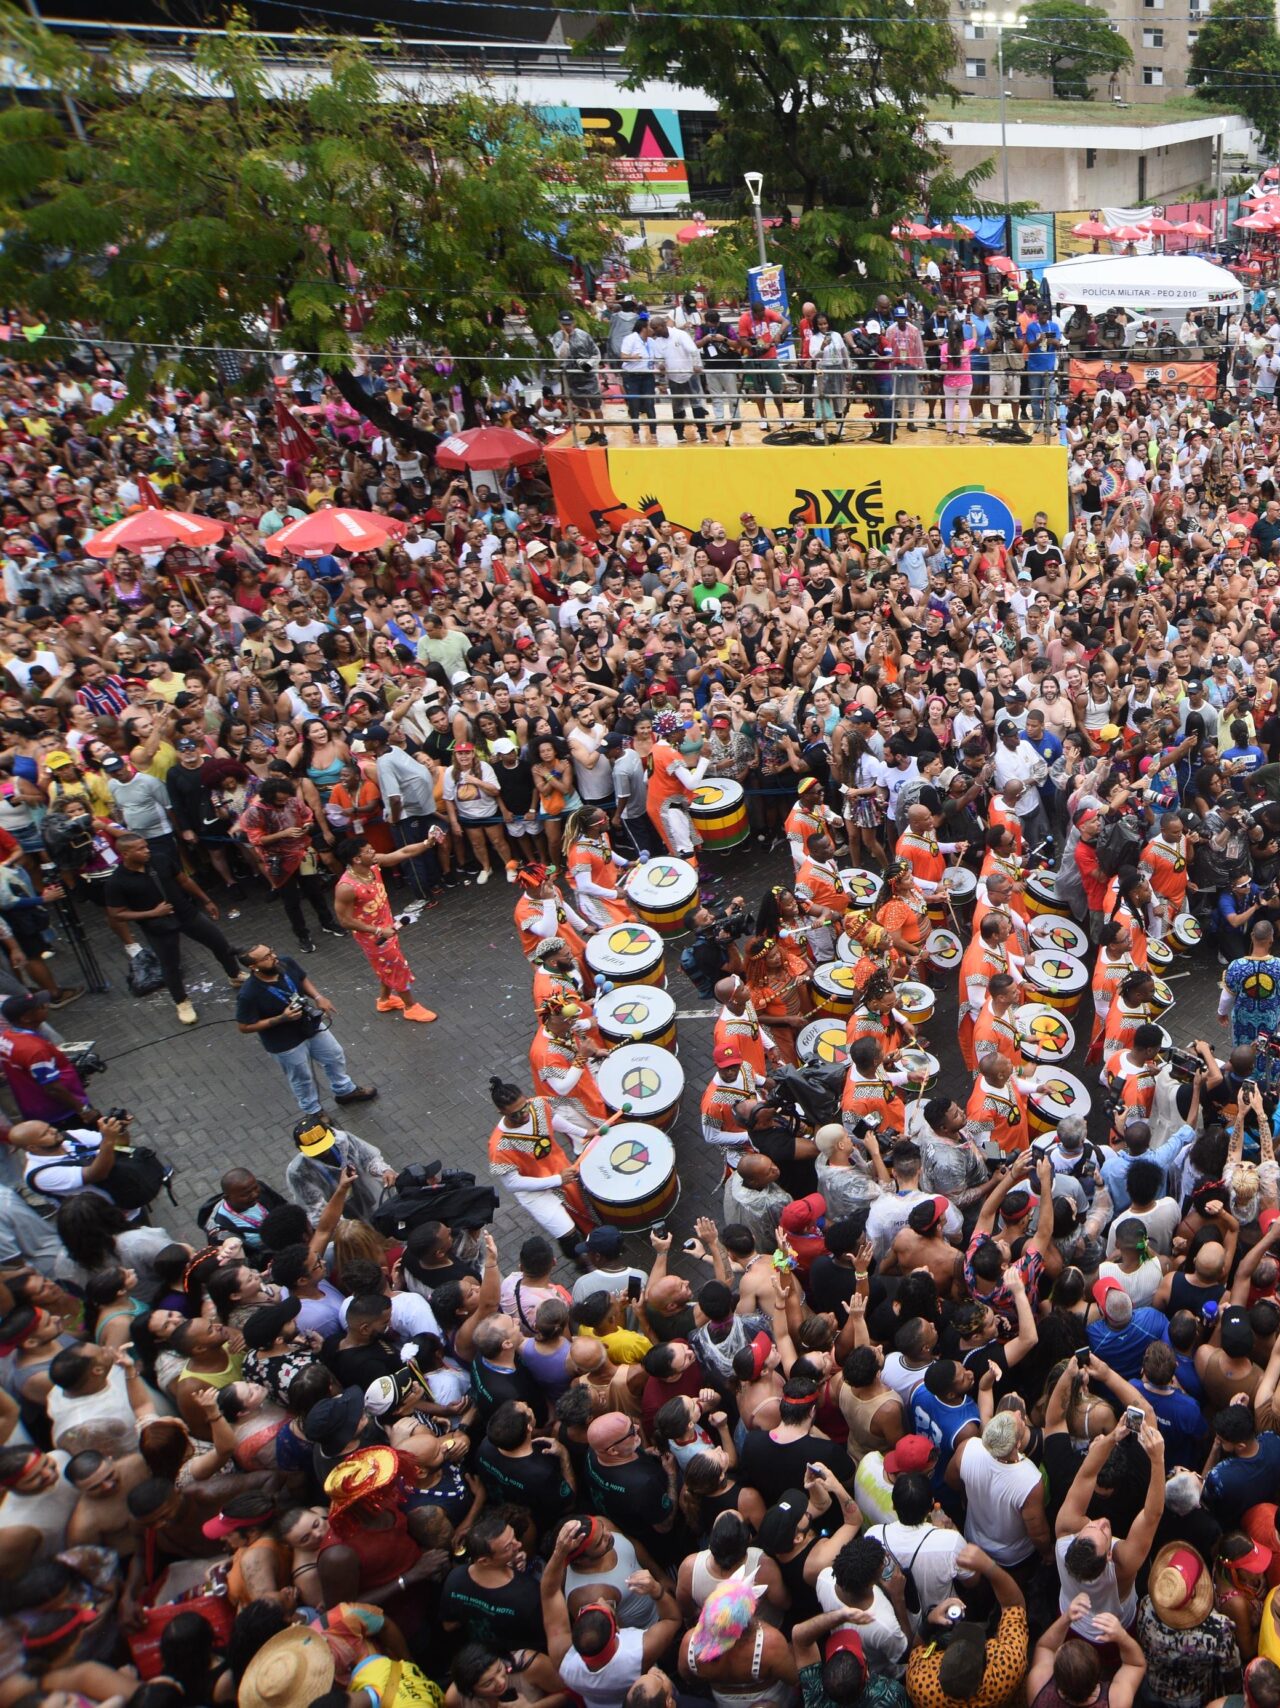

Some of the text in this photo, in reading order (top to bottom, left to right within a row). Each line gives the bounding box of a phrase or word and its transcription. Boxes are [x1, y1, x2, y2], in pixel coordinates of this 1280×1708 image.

[1083, 287, 1116, 296] POLÍCIA
[1117, 289, 1150, 297] MILITAR
[1176, 290, 1197, 298] 2.010
[802, 1024, 821, 1047] GOPE
[509, 1478, 525, 1490] HOTEL
[610, 1484, 626, 1493] HOTEL
[495, 1606, 516, 1616] HOTEL
